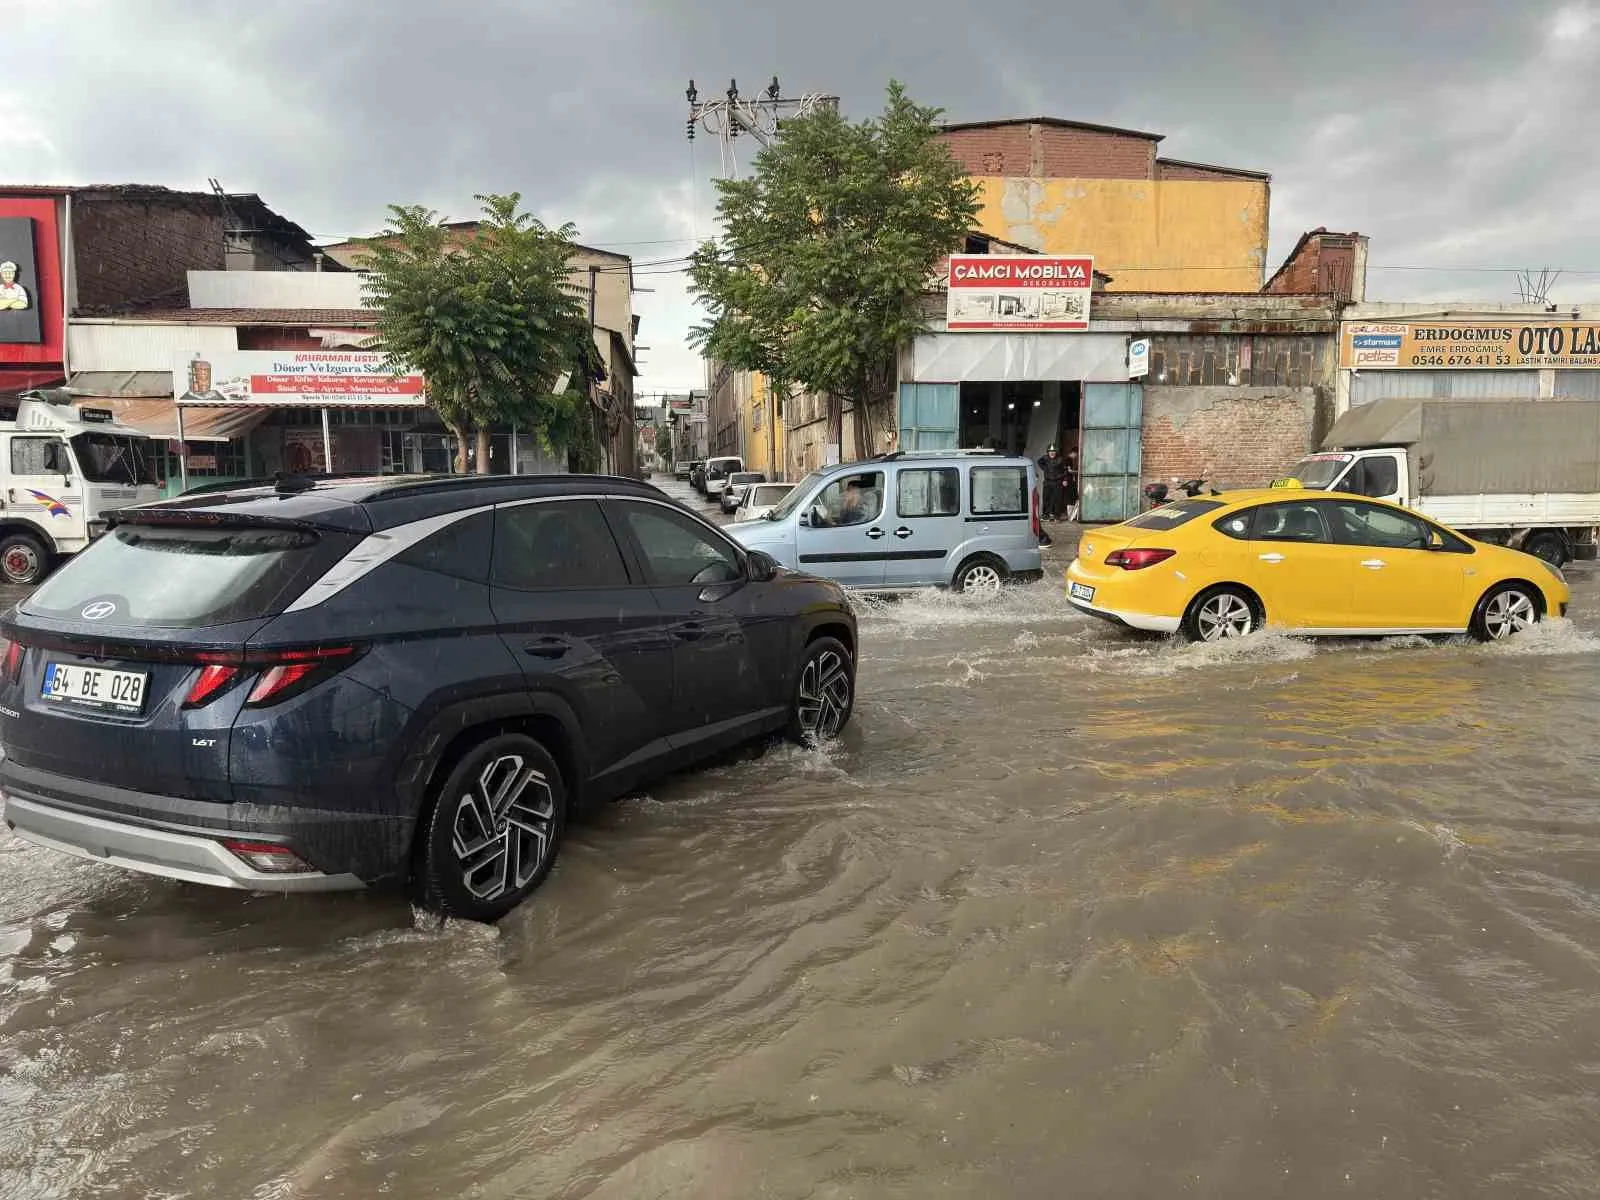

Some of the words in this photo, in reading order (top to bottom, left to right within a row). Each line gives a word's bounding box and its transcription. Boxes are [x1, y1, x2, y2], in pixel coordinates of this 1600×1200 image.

[955, 264, 1011, 280] ÇAMCI
[1016, 261, 1086, 279] MOBİLYA
[1518, 327, 1564, 355] OTO
[1420, 345, 1447, 353] EMRE
[295, 353, 351, 362] KAHRAMAN
[354, 353, 378, 362] USTA
[1357, 350, 1397, 364] petlas
[1412, 355, 1443, 365] 0546
[1447, 355, 1471, 365] 676
[1475, 355, 1490, 365] 41
[1496, 354, 1511, 365] 53
[273, 362, 307, 373] Döner
[310, 363, 325, 373] Ve
[52, 668, 69, 693] 64
[81, 671, 102, 697] BE
[111, 674, 142, 702] 028
